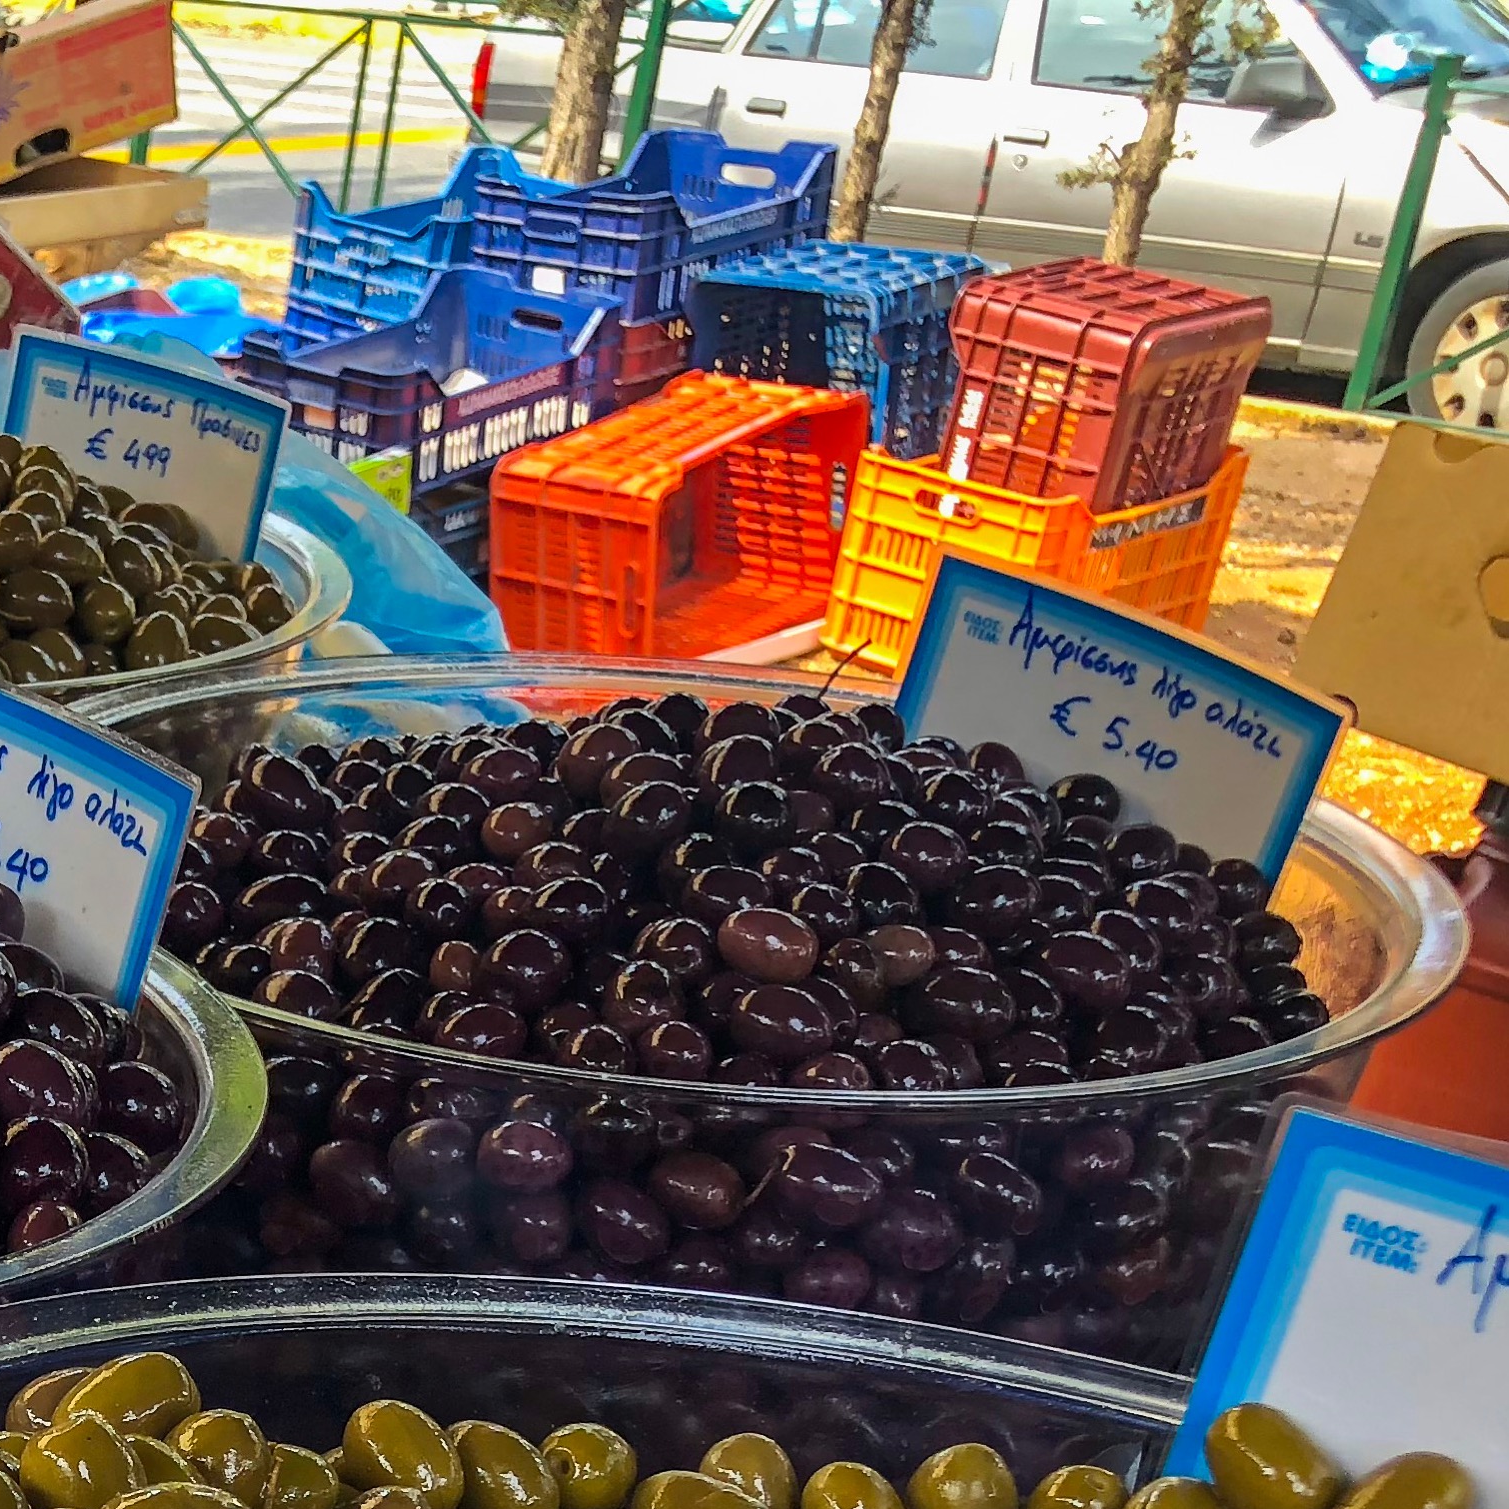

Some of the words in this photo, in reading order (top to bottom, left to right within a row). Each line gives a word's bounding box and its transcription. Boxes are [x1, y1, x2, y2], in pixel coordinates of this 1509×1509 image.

[1049, 696, 1092, 738] €
[1102, 715, 1179, 772] 5.40
[1342, 1213, 1427, 1253] ΕΙΔΟΣ:
